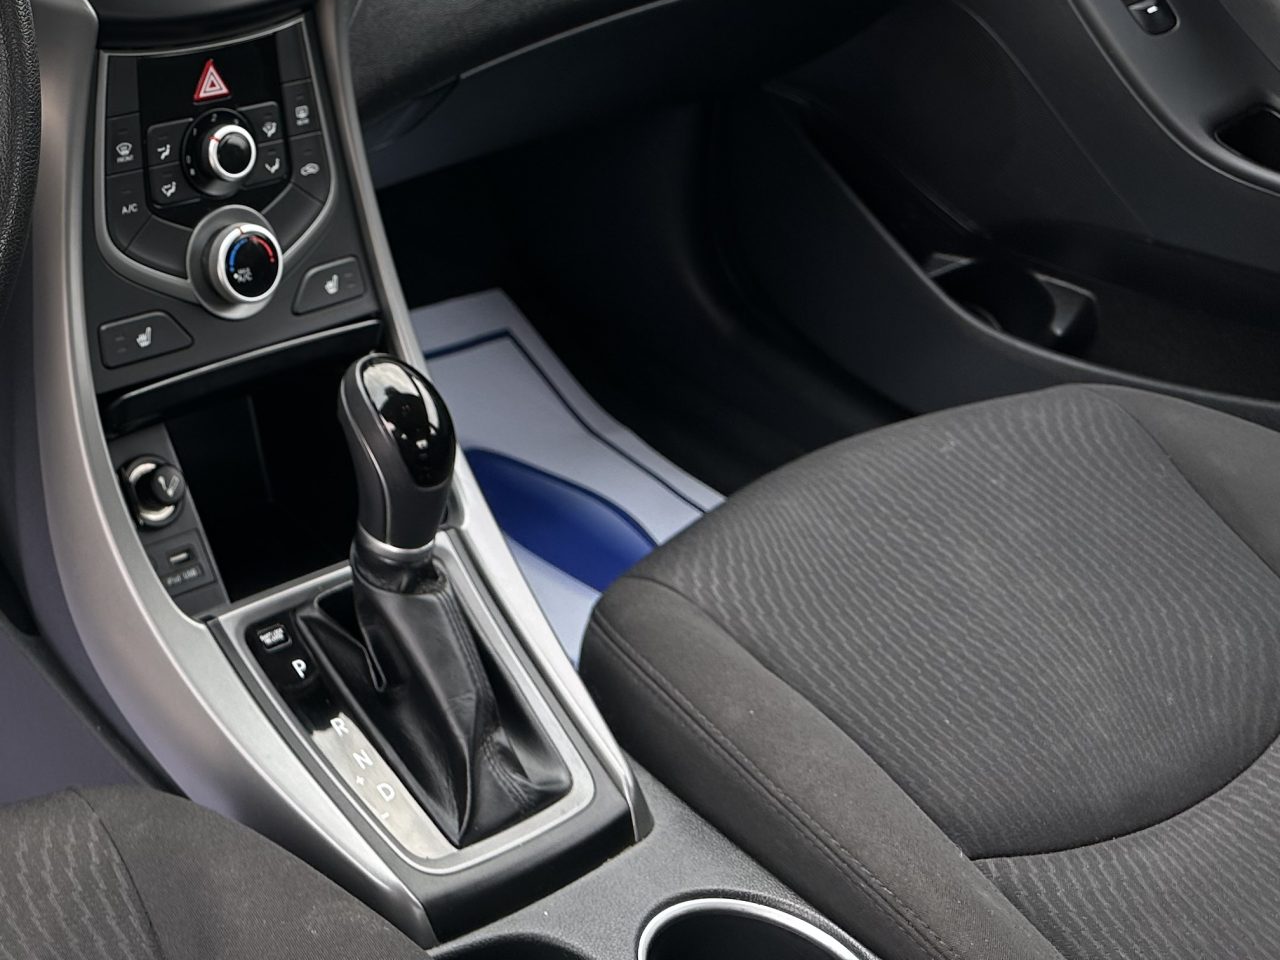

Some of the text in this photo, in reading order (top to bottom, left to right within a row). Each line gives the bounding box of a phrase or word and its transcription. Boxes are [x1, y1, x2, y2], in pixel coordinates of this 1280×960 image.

[121, 203, 139, 215] A/C
[291, 658, 307, 679] P
[330, 717, 349, 737] R
[352, 748, 373, 770] N
[376, 782, 396, 802] D
